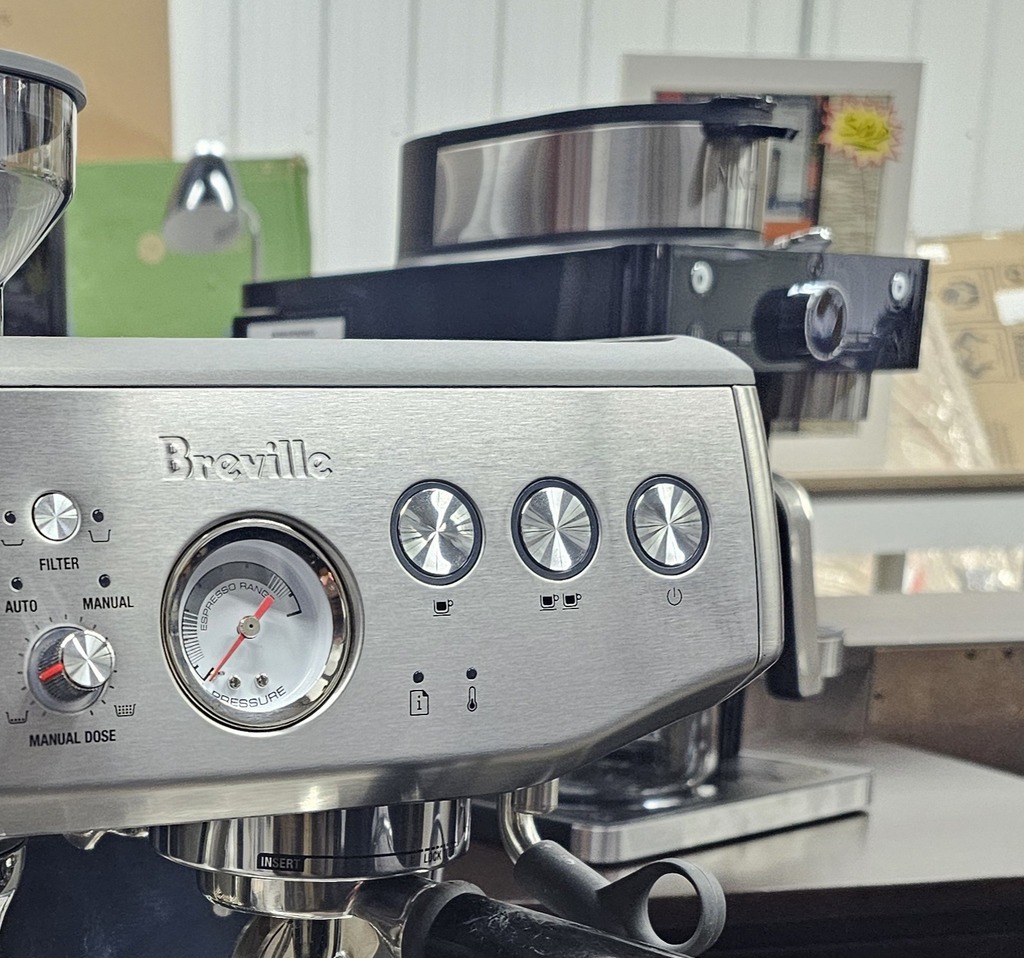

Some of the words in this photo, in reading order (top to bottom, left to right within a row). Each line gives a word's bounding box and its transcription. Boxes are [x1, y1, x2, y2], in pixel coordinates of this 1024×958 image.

[159, 435, 334, 481] Breville
[39, 556, 80, 571] FILTER
[5, 599, 39, 614] AUTO
[82, 595, 135, 611] MANUAL
[199, 581, 237, 632] ESPRESSO
[29, 731, 82, 748] MANUAL
[84, 729, 117, 744] DOSE
[260, 856, 301, 870] INSERT
[423, 850, 442, 864] LOCK
